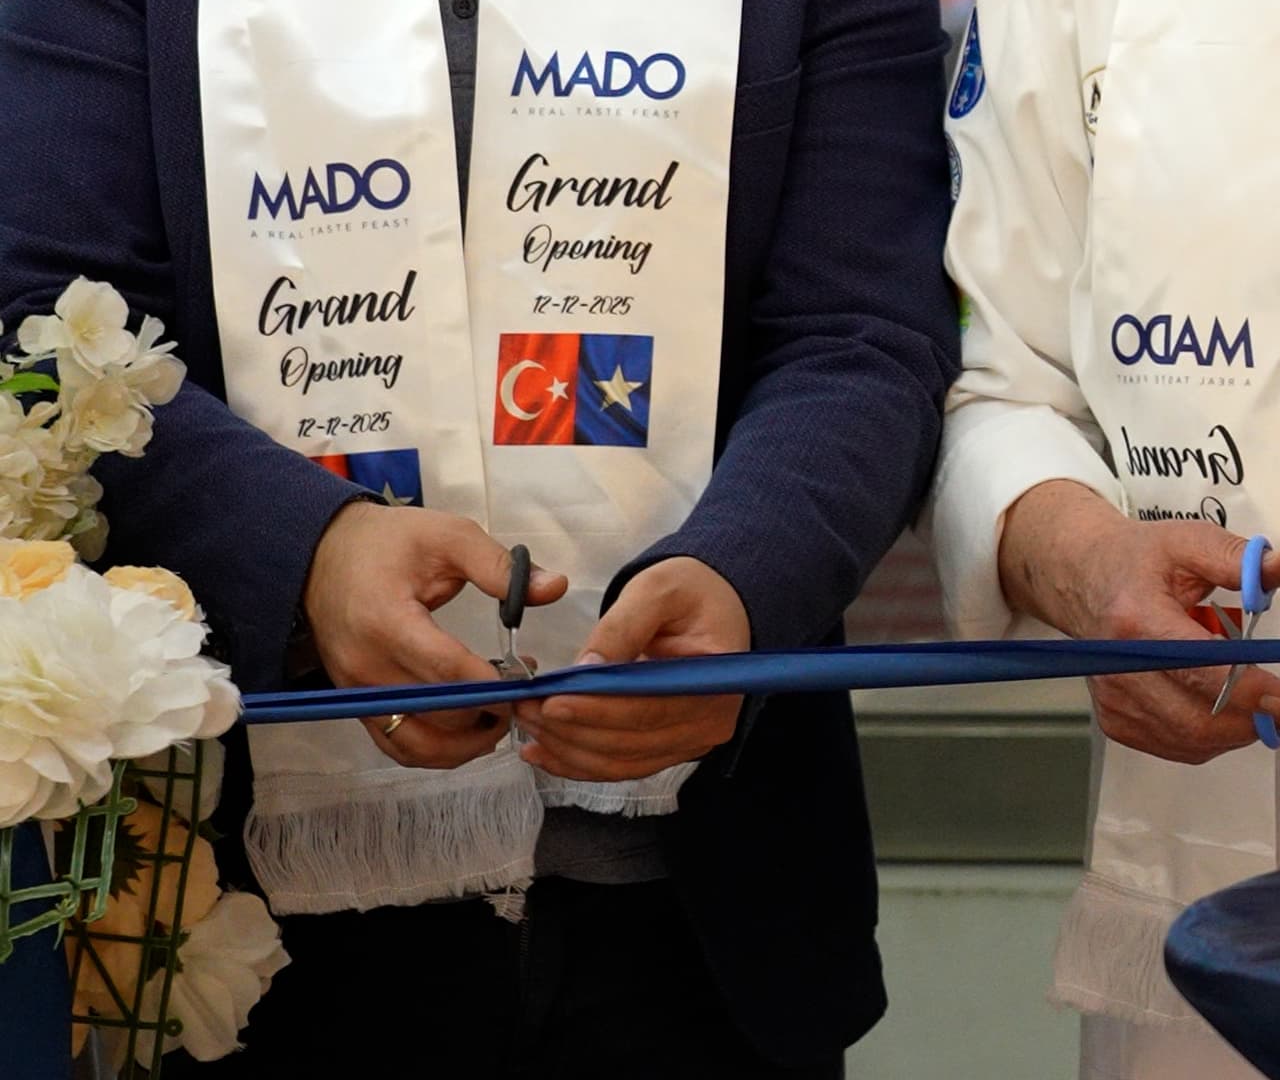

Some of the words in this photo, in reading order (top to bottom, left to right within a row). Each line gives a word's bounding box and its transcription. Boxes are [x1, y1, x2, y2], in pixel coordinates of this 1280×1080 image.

[510, 47, 686, 100] MADO
[511, 107, 519, 115] A
[528, 107, 566, 117] REAL
[576, 107, 622, 117] TASTE
[632, 108, 680, 119] FEAST
[248, 158, 411, 221] MADO
[506, 153, 680, 213] Grand
[250, 230, 258, 238] A
[268, 230, 304, 240] REAL
[310, 222, 352, 236] TASTE
[362, 218, 410, 230] FEAST
[523, 224, 653, 275] Opening
[258, 270, 417, 336] Grand
[532, 295, 634, 316] 12-12-2025
[280, 346, 403, 396] Opening
[298, 411, 393, 438] 12-12-2025
